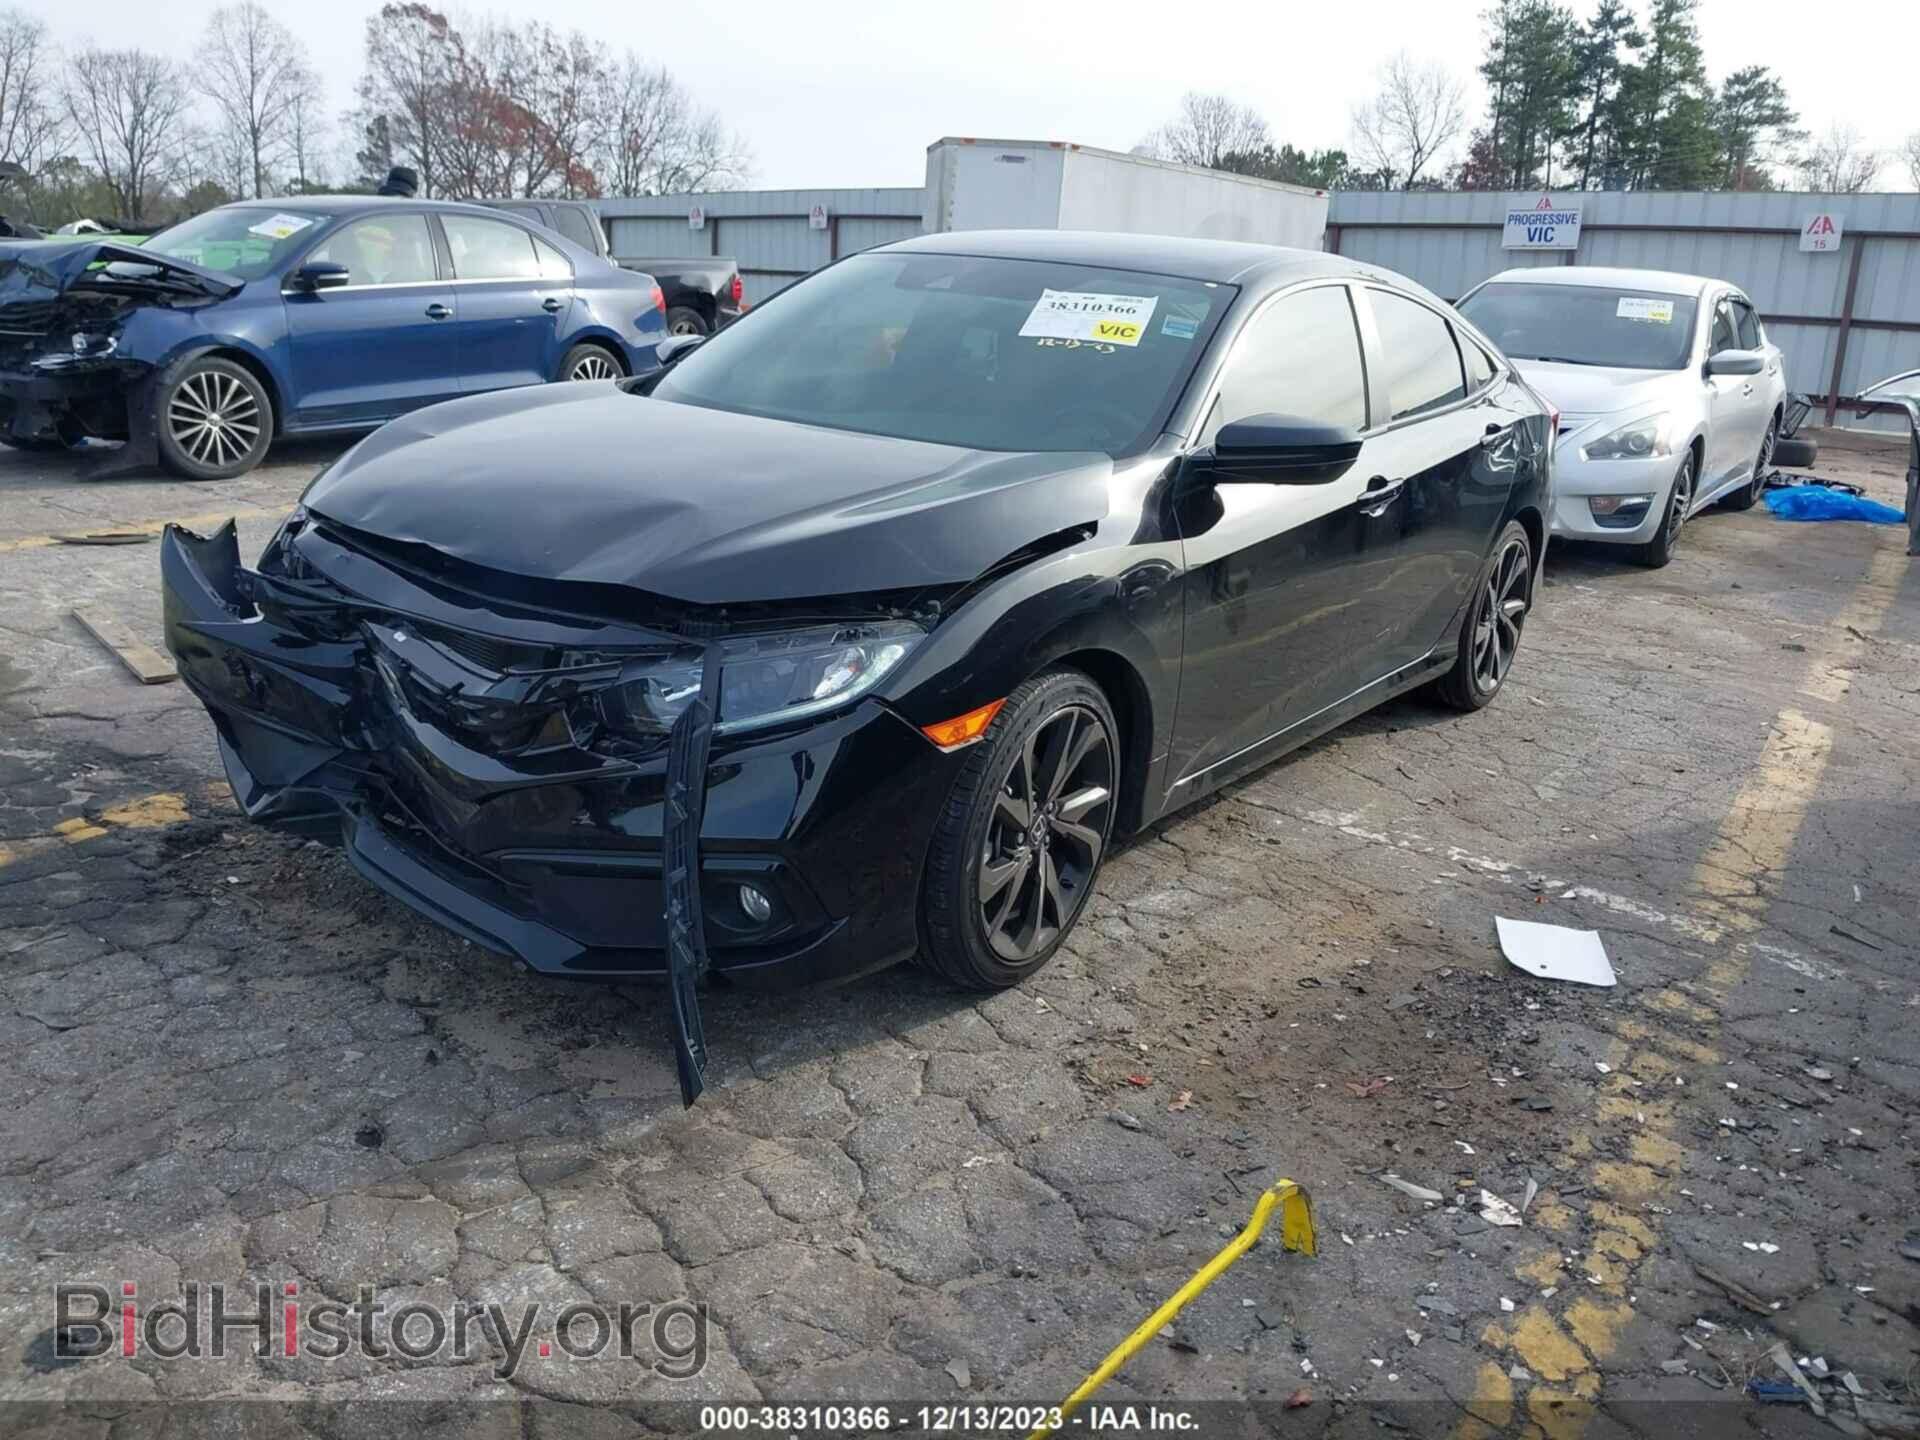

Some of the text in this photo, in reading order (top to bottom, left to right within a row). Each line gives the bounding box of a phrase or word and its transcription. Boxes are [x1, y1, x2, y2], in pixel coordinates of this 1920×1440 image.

[1507, 213, 1578, 225] PROGRESSIVE
[1527, 226, 1555, 243] VIC
[1100, 324, 1136, 338] VIC
